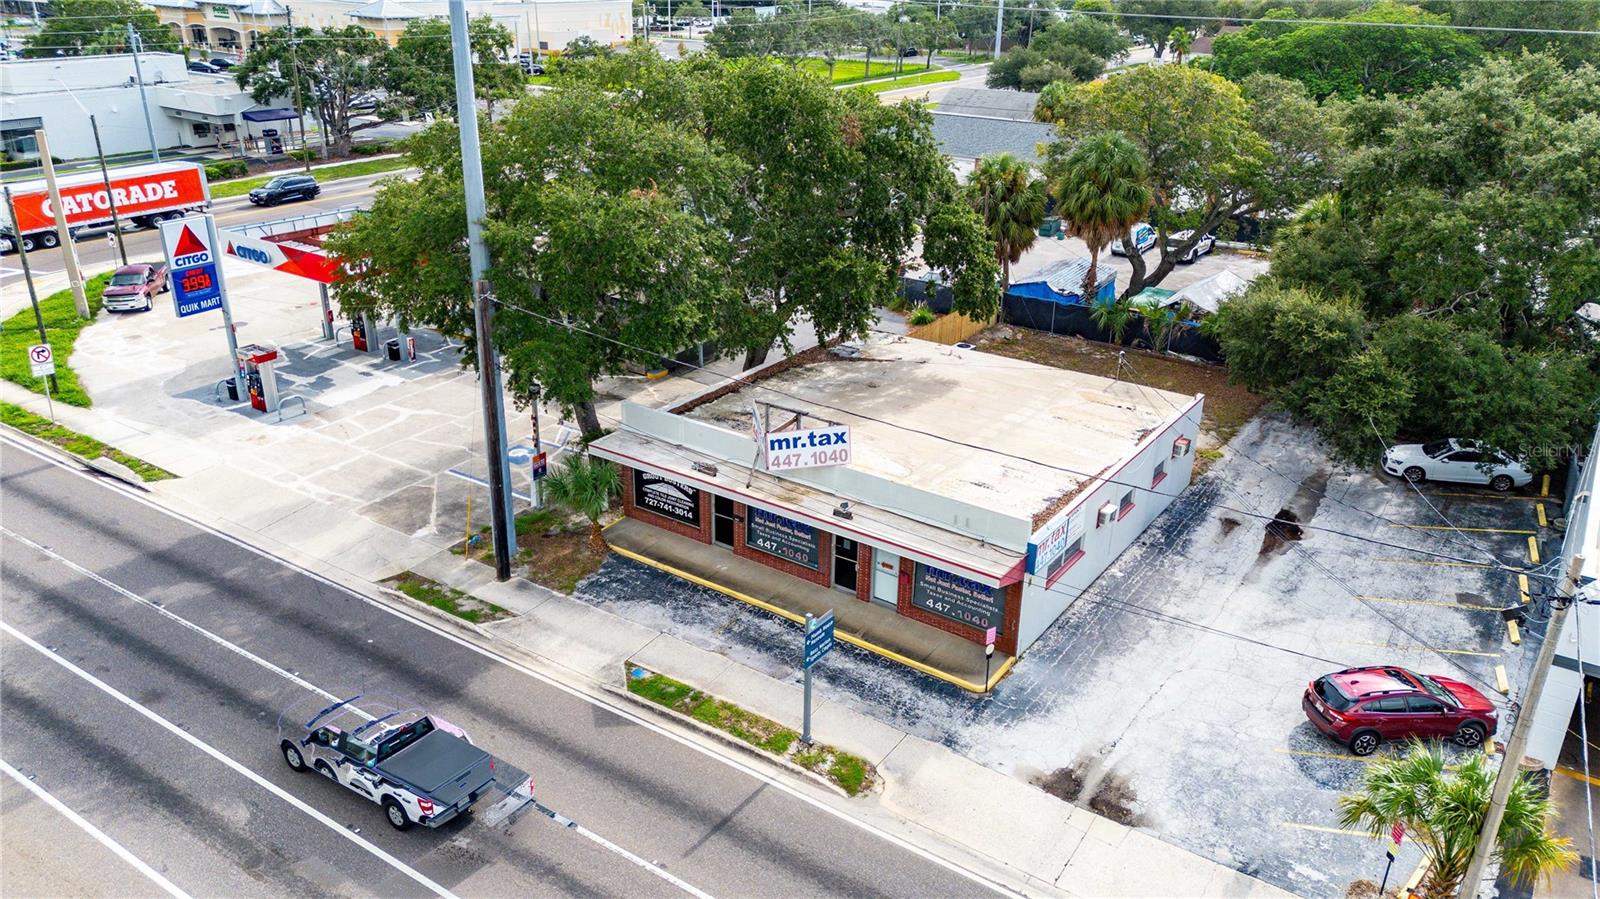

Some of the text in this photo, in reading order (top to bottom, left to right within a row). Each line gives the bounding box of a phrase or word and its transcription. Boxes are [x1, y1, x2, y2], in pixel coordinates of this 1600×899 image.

[41, 179, 178, 217] GATORADE
[175, 252, 209, 267] CITGO
[236, 245, 270, 264] CITGO
[180, 296, 221, 314] QUIK MART
[769, 431, 847, 451] mr.tax
[771, 449, 848, 468] 447.1040
[644, 496, 693, 519] 727-741-3014
[920, 581, 999, 612] Small Business Specialists
[926, 589, 943, 598] Taxes
[956, 600, 991, 617] Accounting
[926, 598, 988, 627] 447.1040
